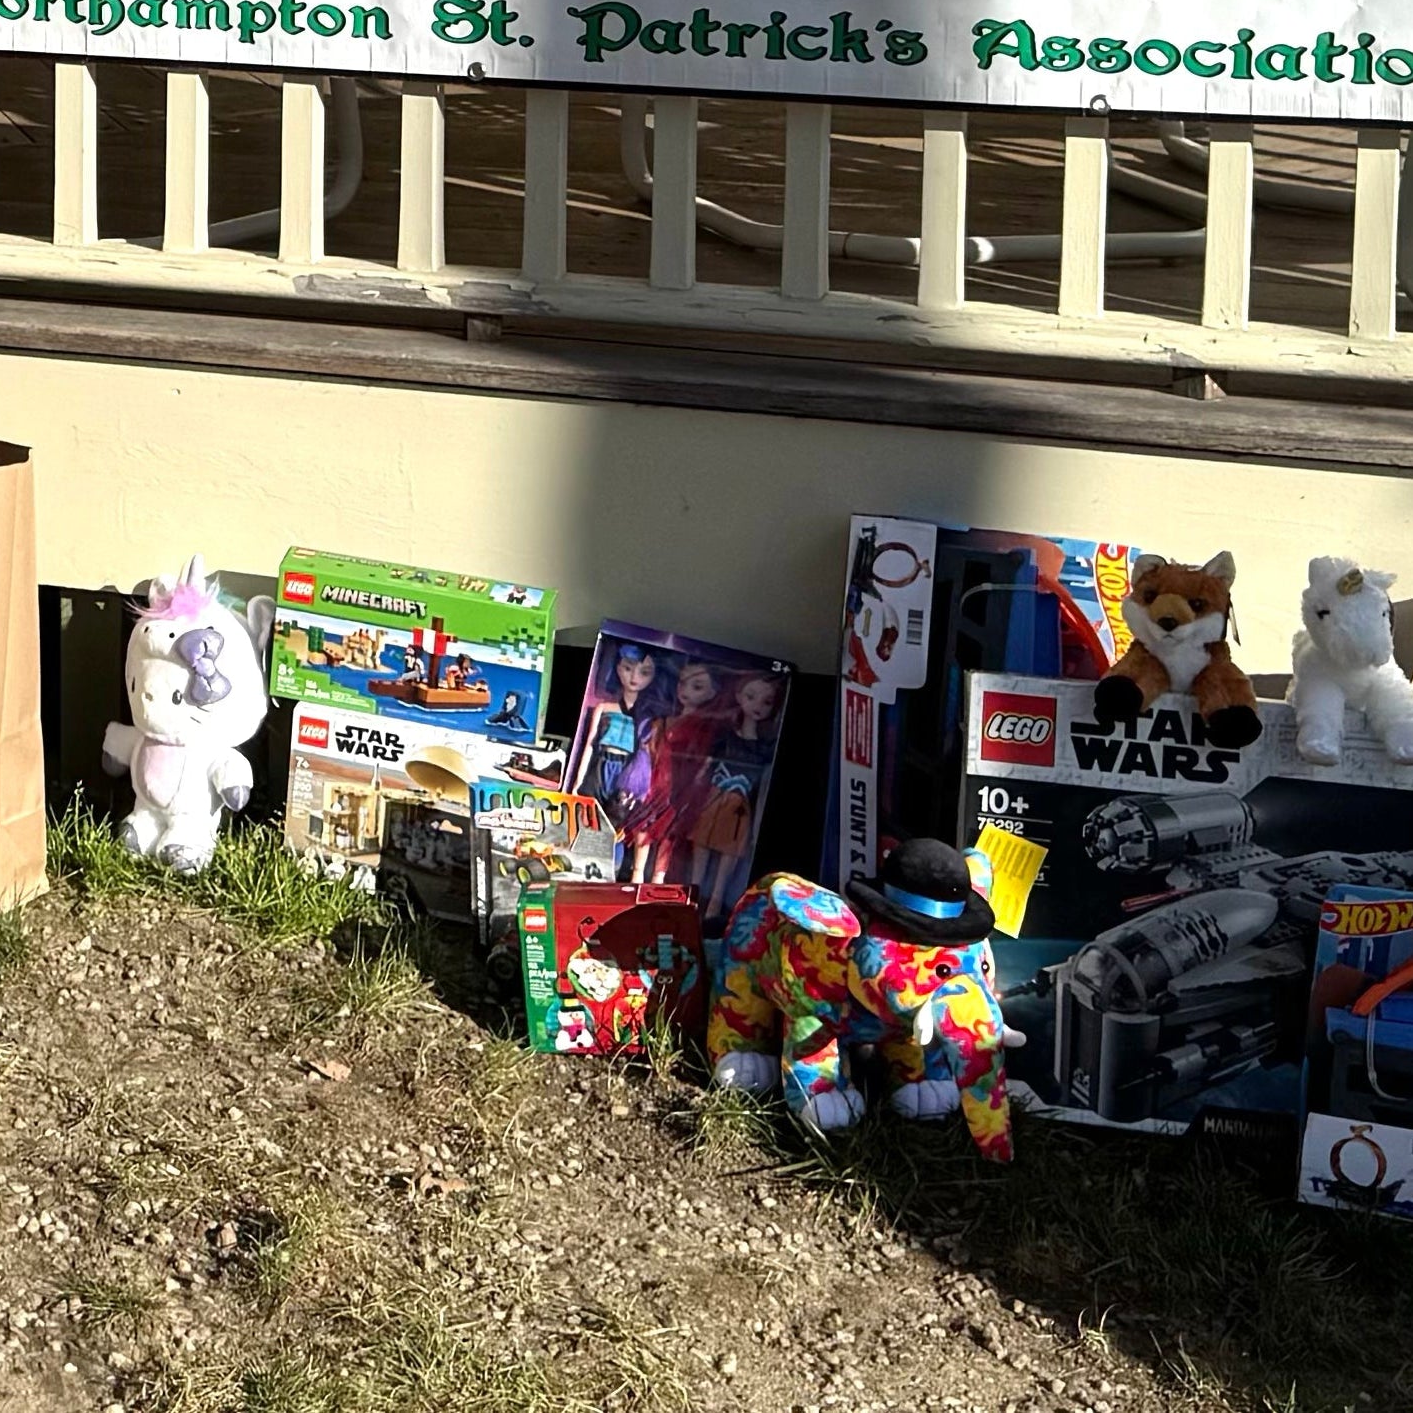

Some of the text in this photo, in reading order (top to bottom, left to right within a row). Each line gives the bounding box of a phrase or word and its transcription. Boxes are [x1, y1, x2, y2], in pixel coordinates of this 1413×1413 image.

[567, 0, 929, 63] Patrick's
[285, 578, 428, 619] LEGO MINECRAFT
[771, 660, 791, 673] 3+
[335, 724, 405, 750] STAR
[986, 712, 1053, 745] LEGO
[335, 737, 404, 763] WARS
[1070, 735, 1241, 785] WARS
[850, 777, 867, 846] STUNT
[977, 785, 1029, 815] 10+
[1331, 903, 1388, 936] HOT
